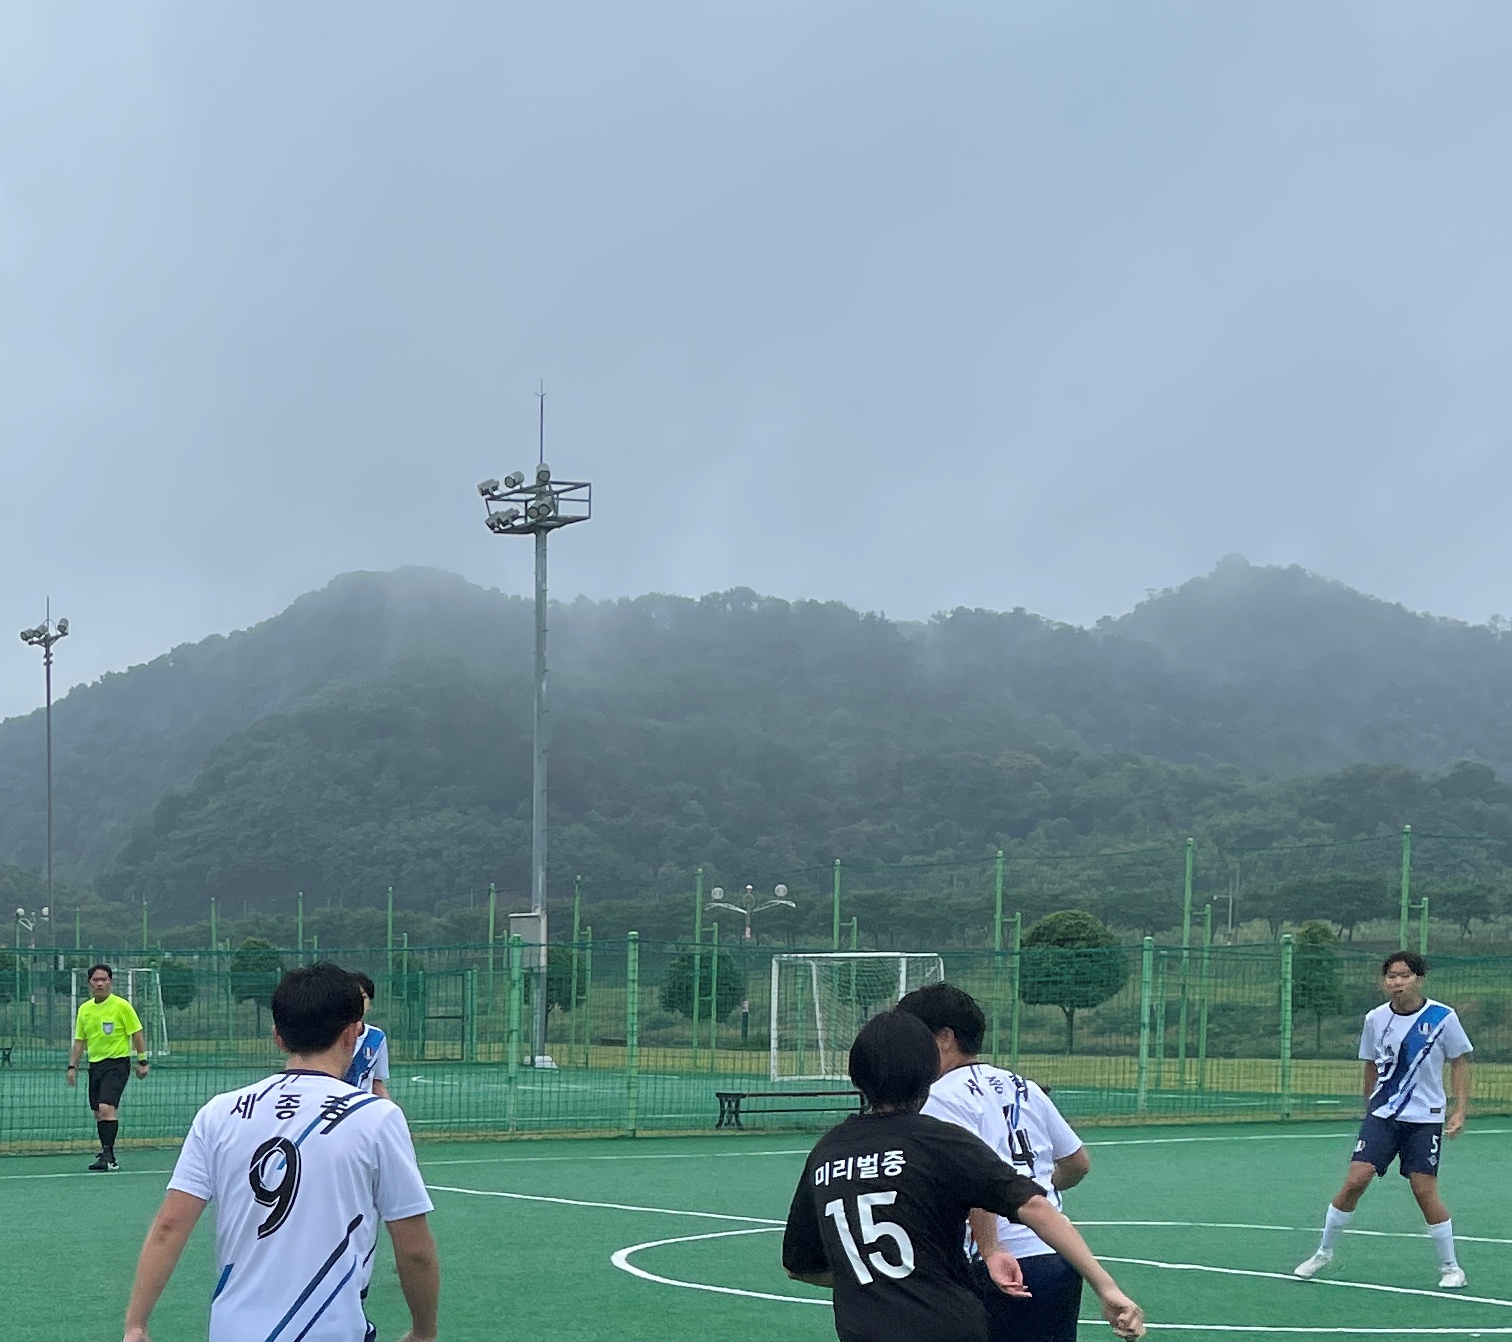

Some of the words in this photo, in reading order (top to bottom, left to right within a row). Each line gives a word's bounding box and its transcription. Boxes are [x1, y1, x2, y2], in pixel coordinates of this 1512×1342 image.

[814, 1150, 907, 1186] 미리벌중
[1430, 1134, 1440, 1154] 5
[248, 1136, 302, 1240] 9
[824, 1190, 916, 1286] 15
